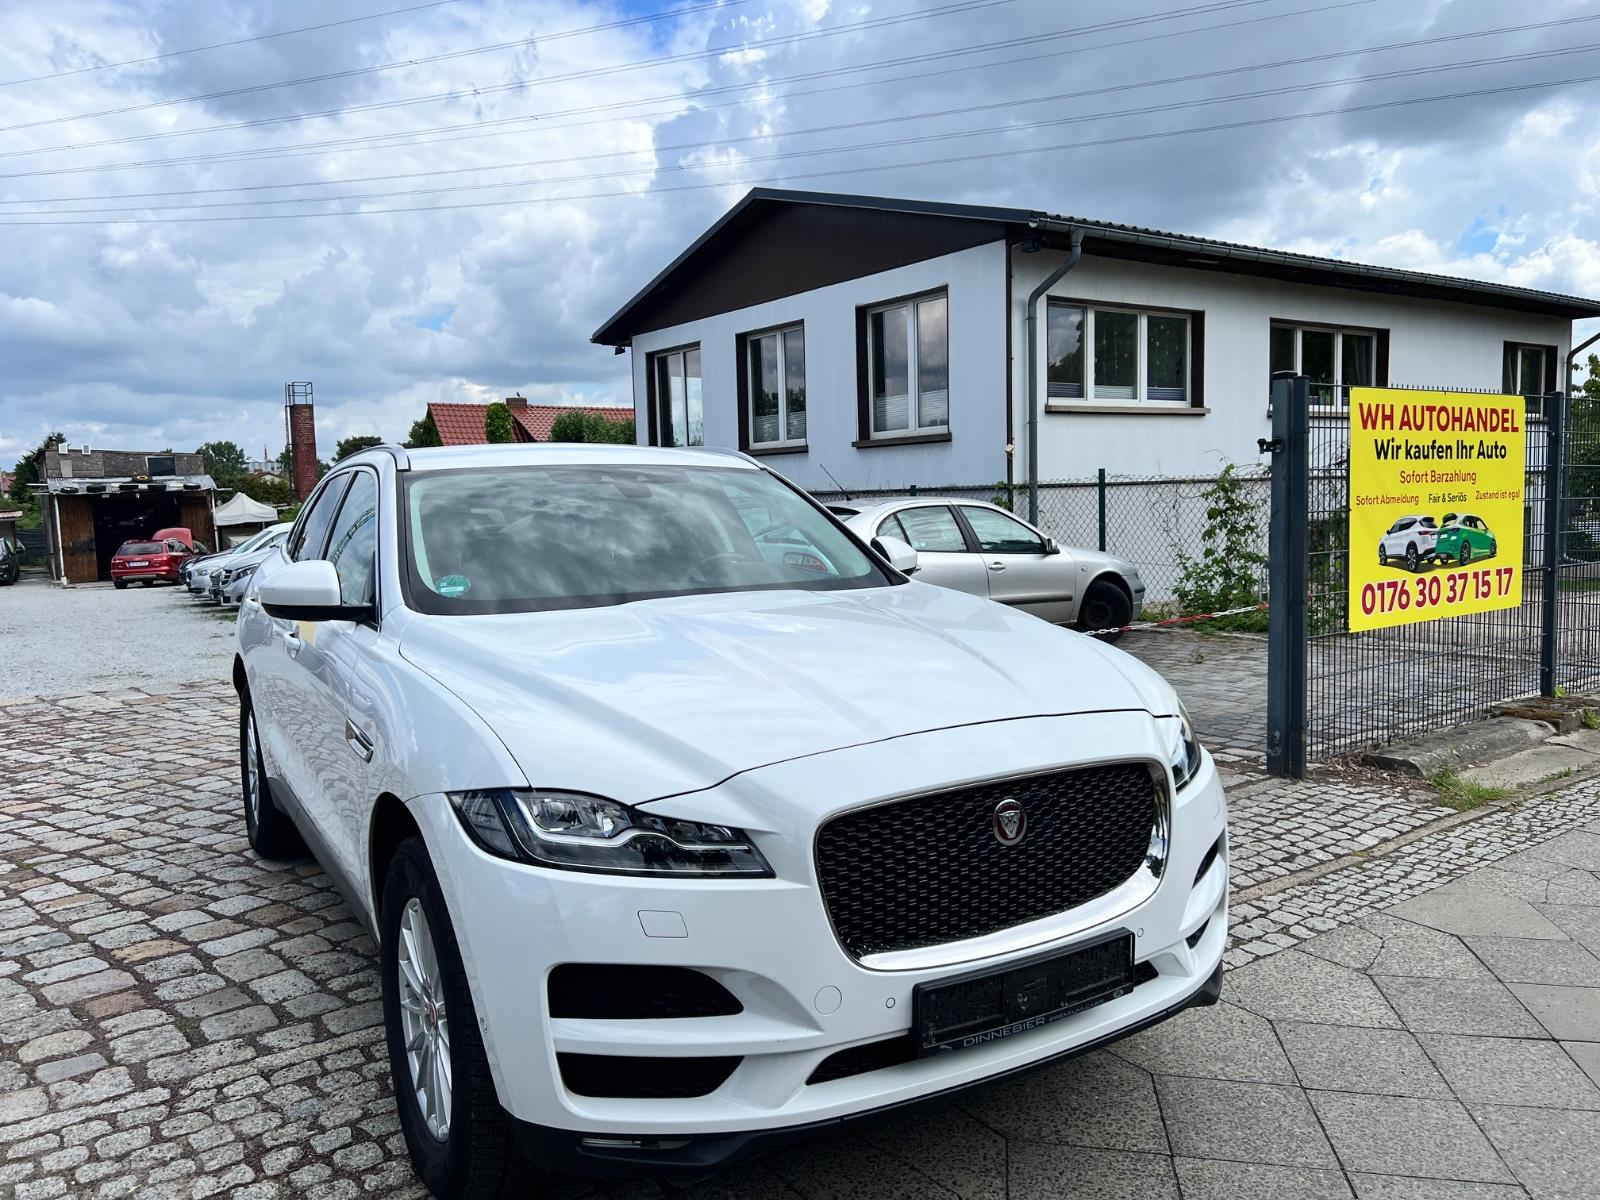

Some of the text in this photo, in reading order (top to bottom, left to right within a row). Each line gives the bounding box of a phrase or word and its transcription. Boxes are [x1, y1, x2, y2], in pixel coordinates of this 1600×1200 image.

[1359, 403, 1519, 432] WH AUTOHANDEL
[1374, 437, 1507, 460] Wir kaufen Ihr Auto
[1400, 469, 1476, 485] Sofort Barzahlung
[1356, 493, 1419, 506] Sofort Abmeldung
[1428, 492, 1467, 503] Fair & Seriös
[1475, 489, 1520, 500] Zustand ist egal
[1361, 567, 1514, 615] 0176 30 37 15 17
[963, 1017, 1046, 1047] DINNEBIER
